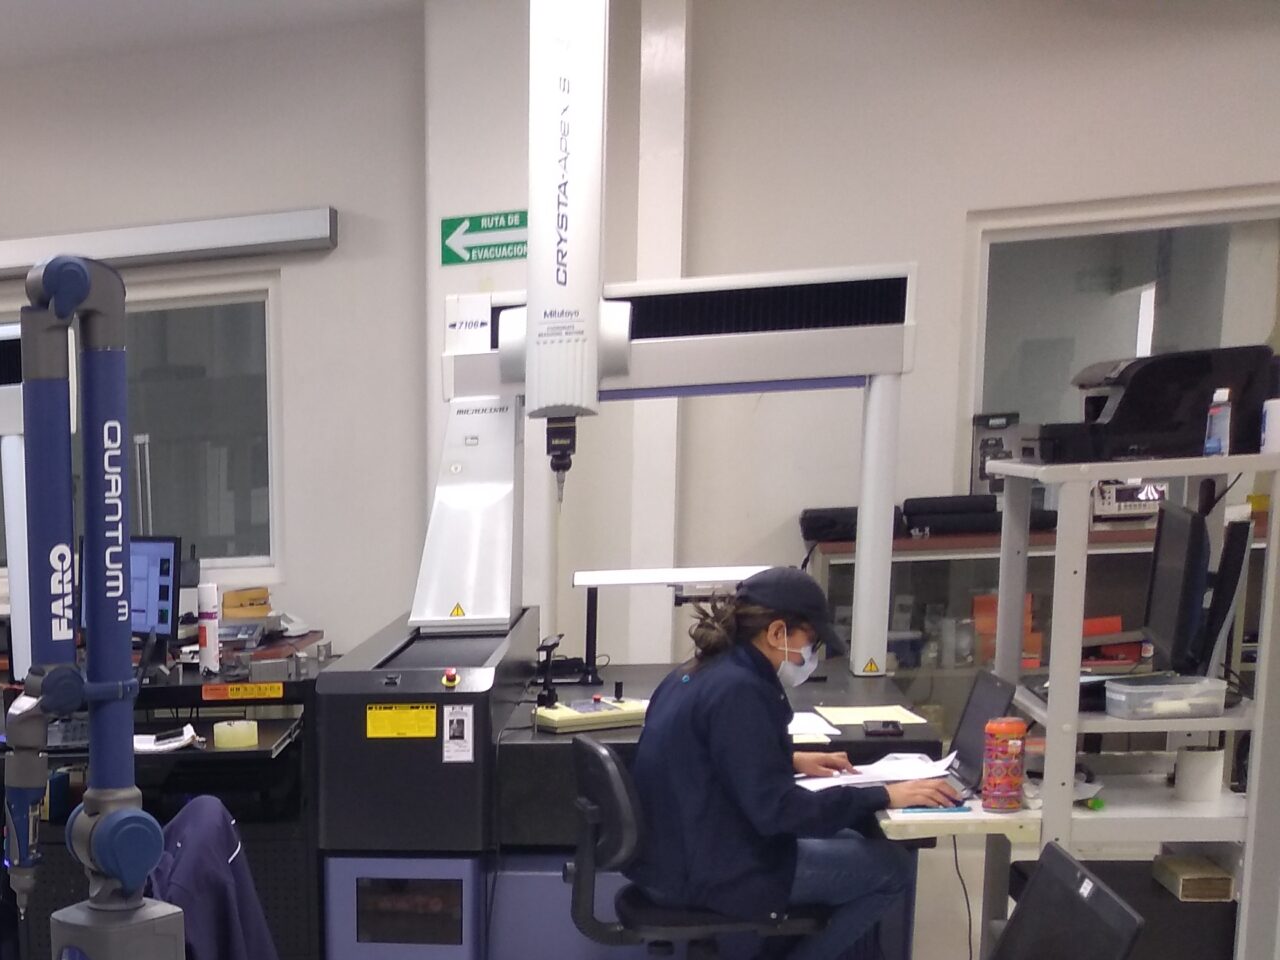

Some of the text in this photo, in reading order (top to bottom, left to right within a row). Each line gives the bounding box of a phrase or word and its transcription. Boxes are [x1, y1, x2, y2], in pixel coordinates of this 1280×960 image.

[481, 215, 520, 228] RUTA DE
[543, 309, 580, 320] Mitutoyo
[49, 543, 74, 641] FARO
